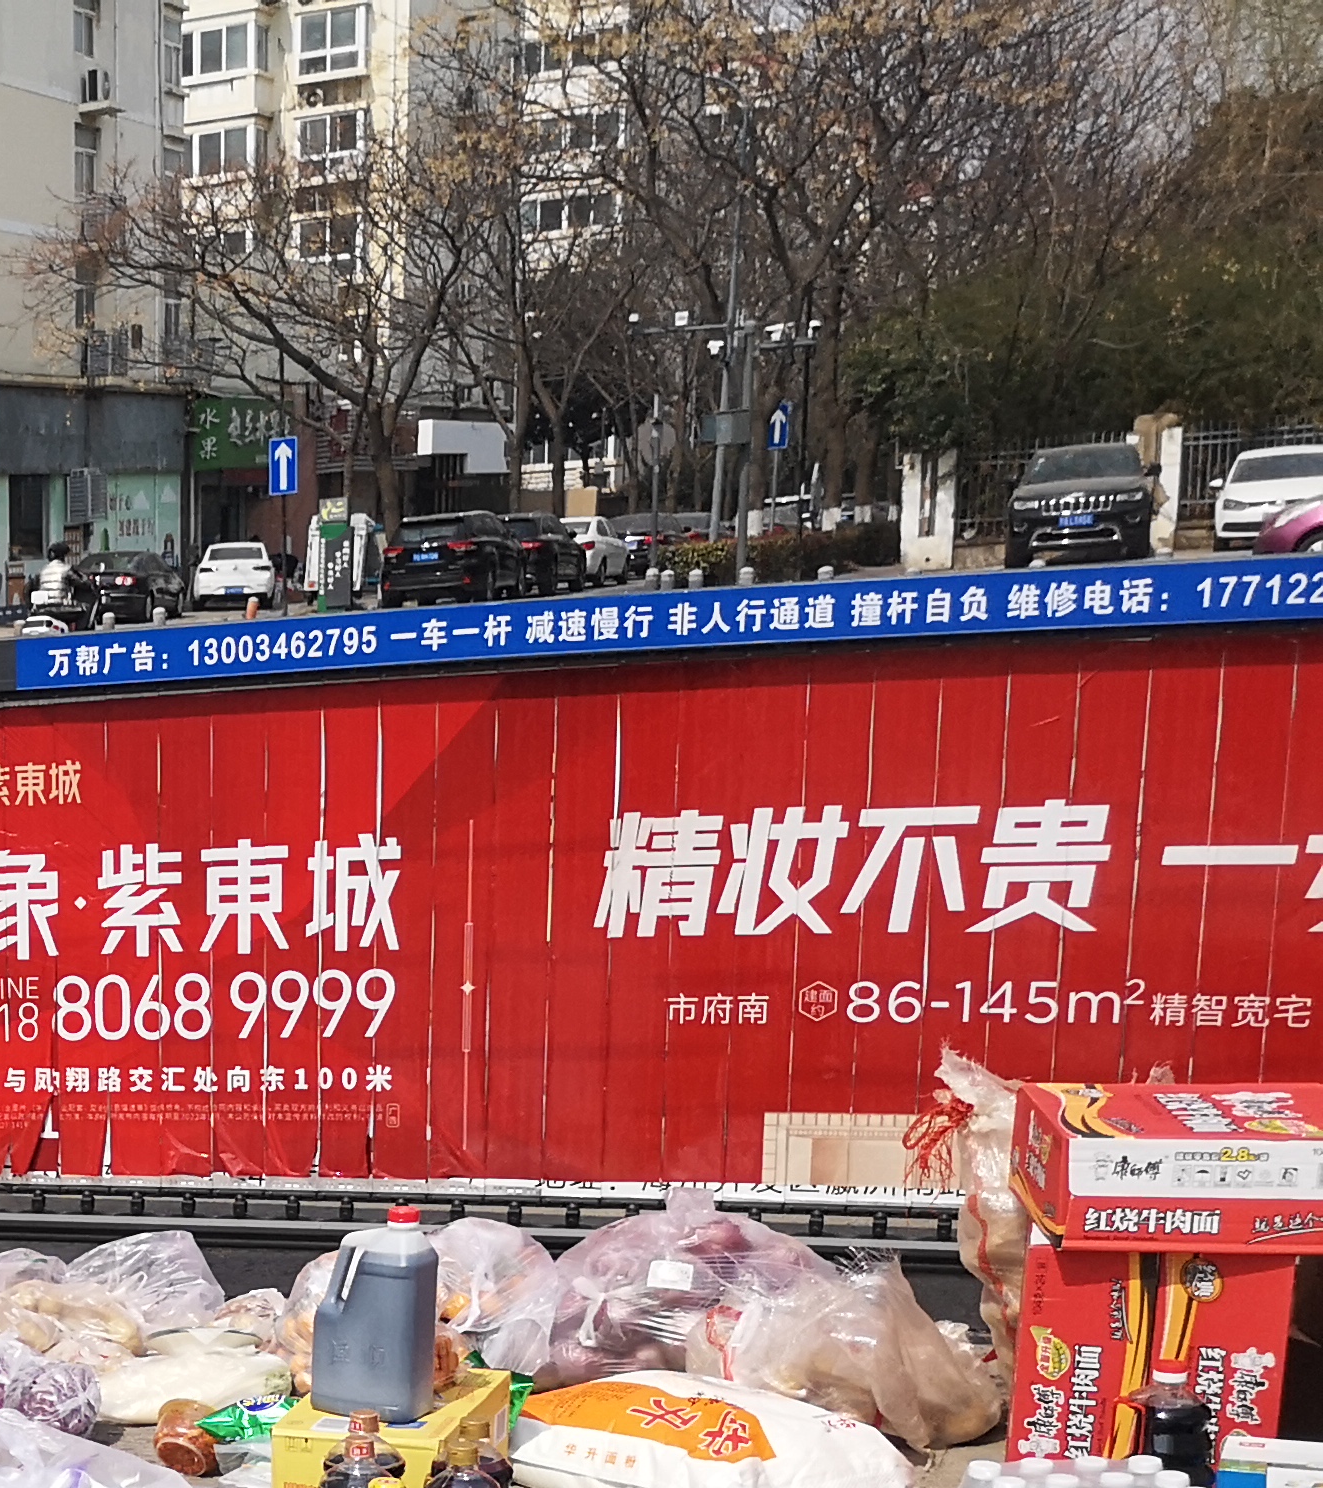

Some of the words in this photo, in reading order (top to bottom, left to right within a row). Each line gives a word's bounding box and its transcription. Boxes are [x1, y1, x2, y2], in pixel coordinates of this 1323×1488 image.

[48, 638, 170, 679] 万帮广告：
[188, 625, 379, 667] 13003462795
[390, 614, 513, 653] 一车一杆
[525, 606, 654, 646] 减速慢行
[667, 593, 837, 636] 非人行通道
[850, 583, 990, 628] 撞杆自负
[1006, 577, 1170, 619] 维修电话：
[594, 799, 1112, 939] 精妆不贵
[1160, 832, 1323, 934] 一
[52, 973, 213, 1042] 8068
[229, 967, 398, 1040] 9999
[667, 992, 770, 1026] 市府南
[1150, 991, 1313, 1029] 精智宽宅
[1083, 1207, 1222, 1235] 红烧牛肉面
[1063, 1344, 1102, 1460] 红烧牛肉面
[563, 1442, 638, 1469] 华升面粉
